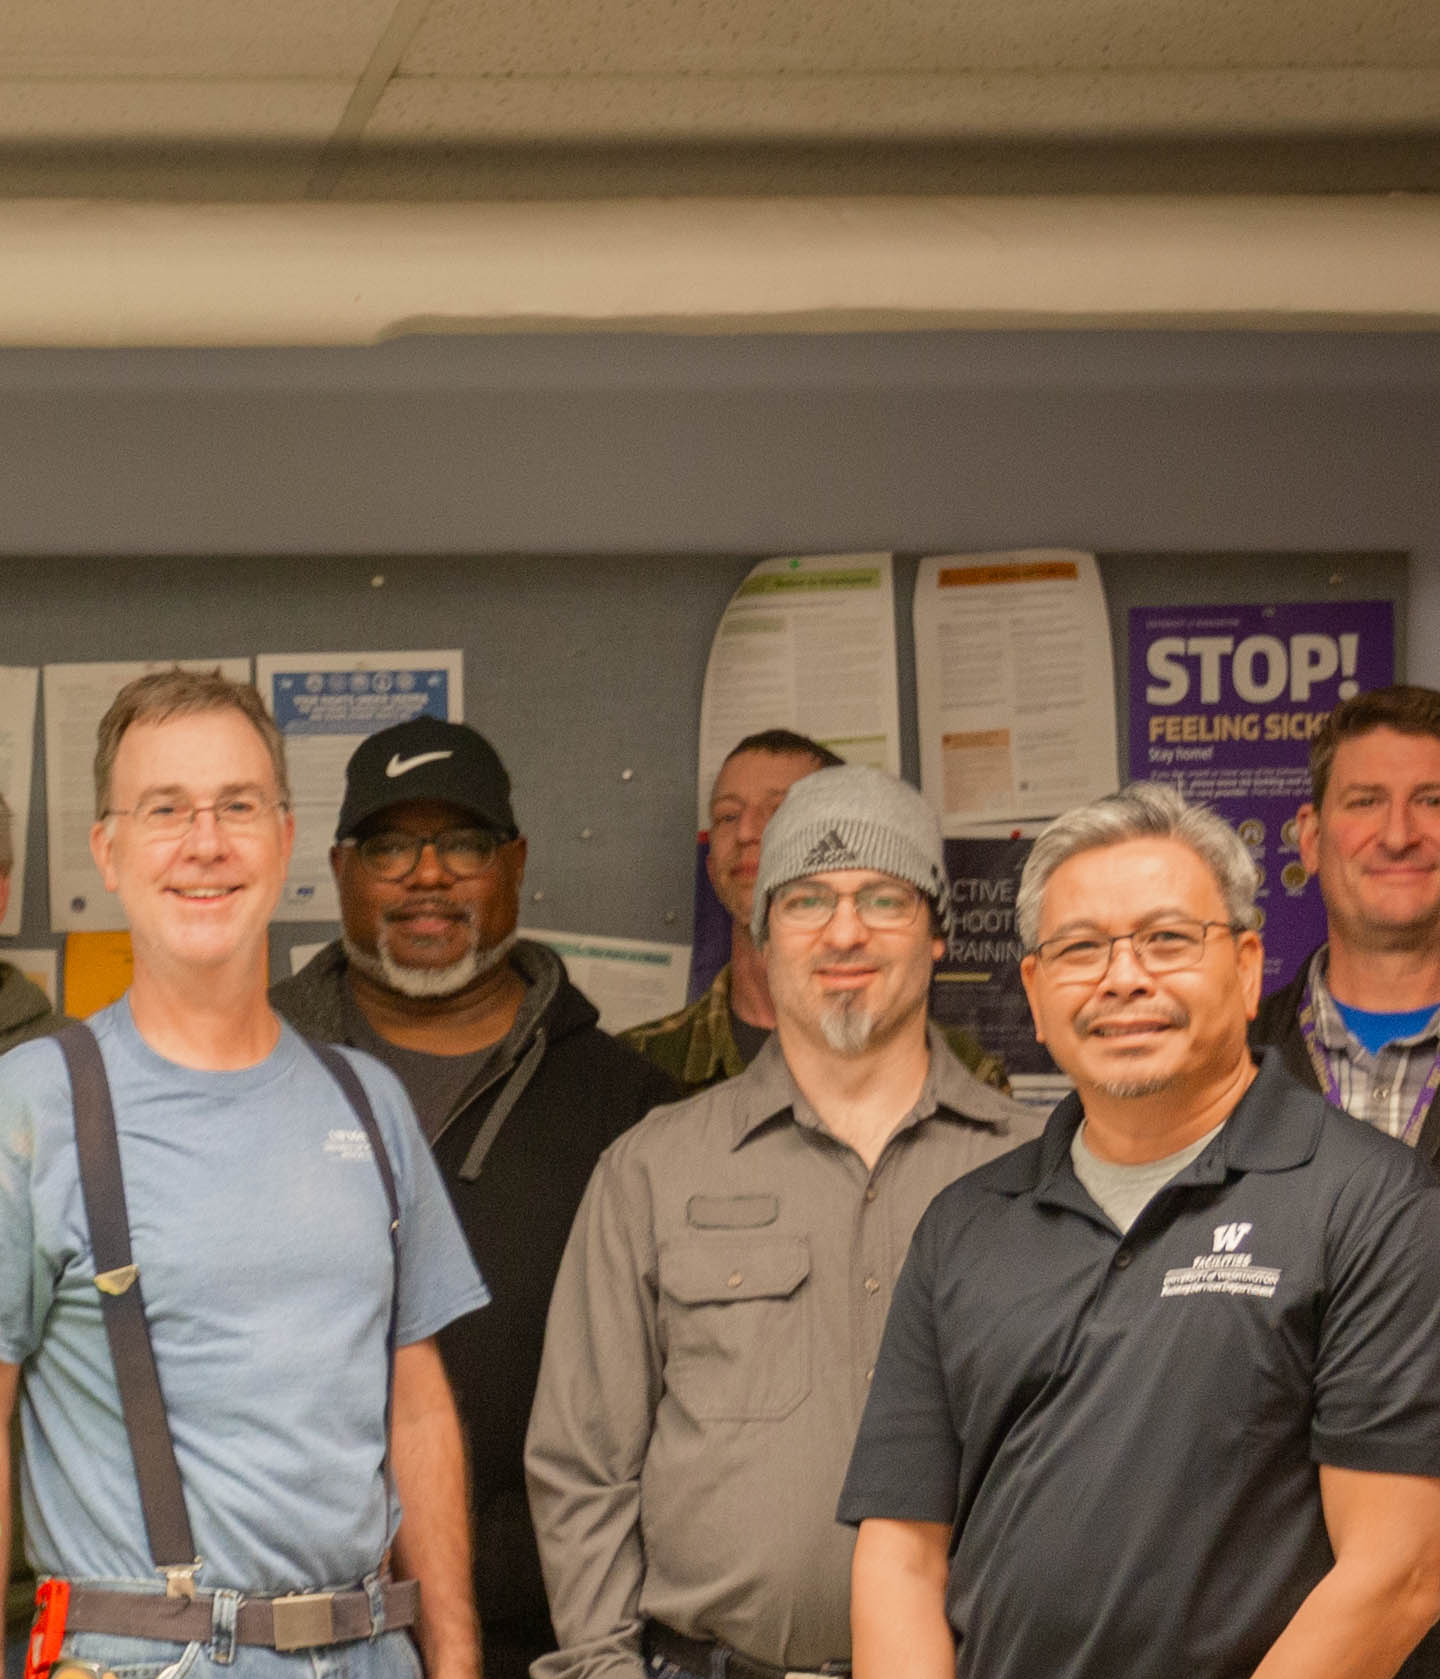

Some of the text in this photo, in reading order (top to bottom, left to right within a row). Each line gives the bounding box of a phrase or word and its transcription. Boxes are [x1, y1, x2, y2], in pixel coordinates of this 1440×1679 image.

[1146, 632, 1360, 707] STOP!
[1148, 711, 1330, 743] FEELING SICK
[950, 878, 1016, 903] CTIVE
[948, 939, 1022, 963] RAININ
[1212, 1222, 1254, 1252] W
